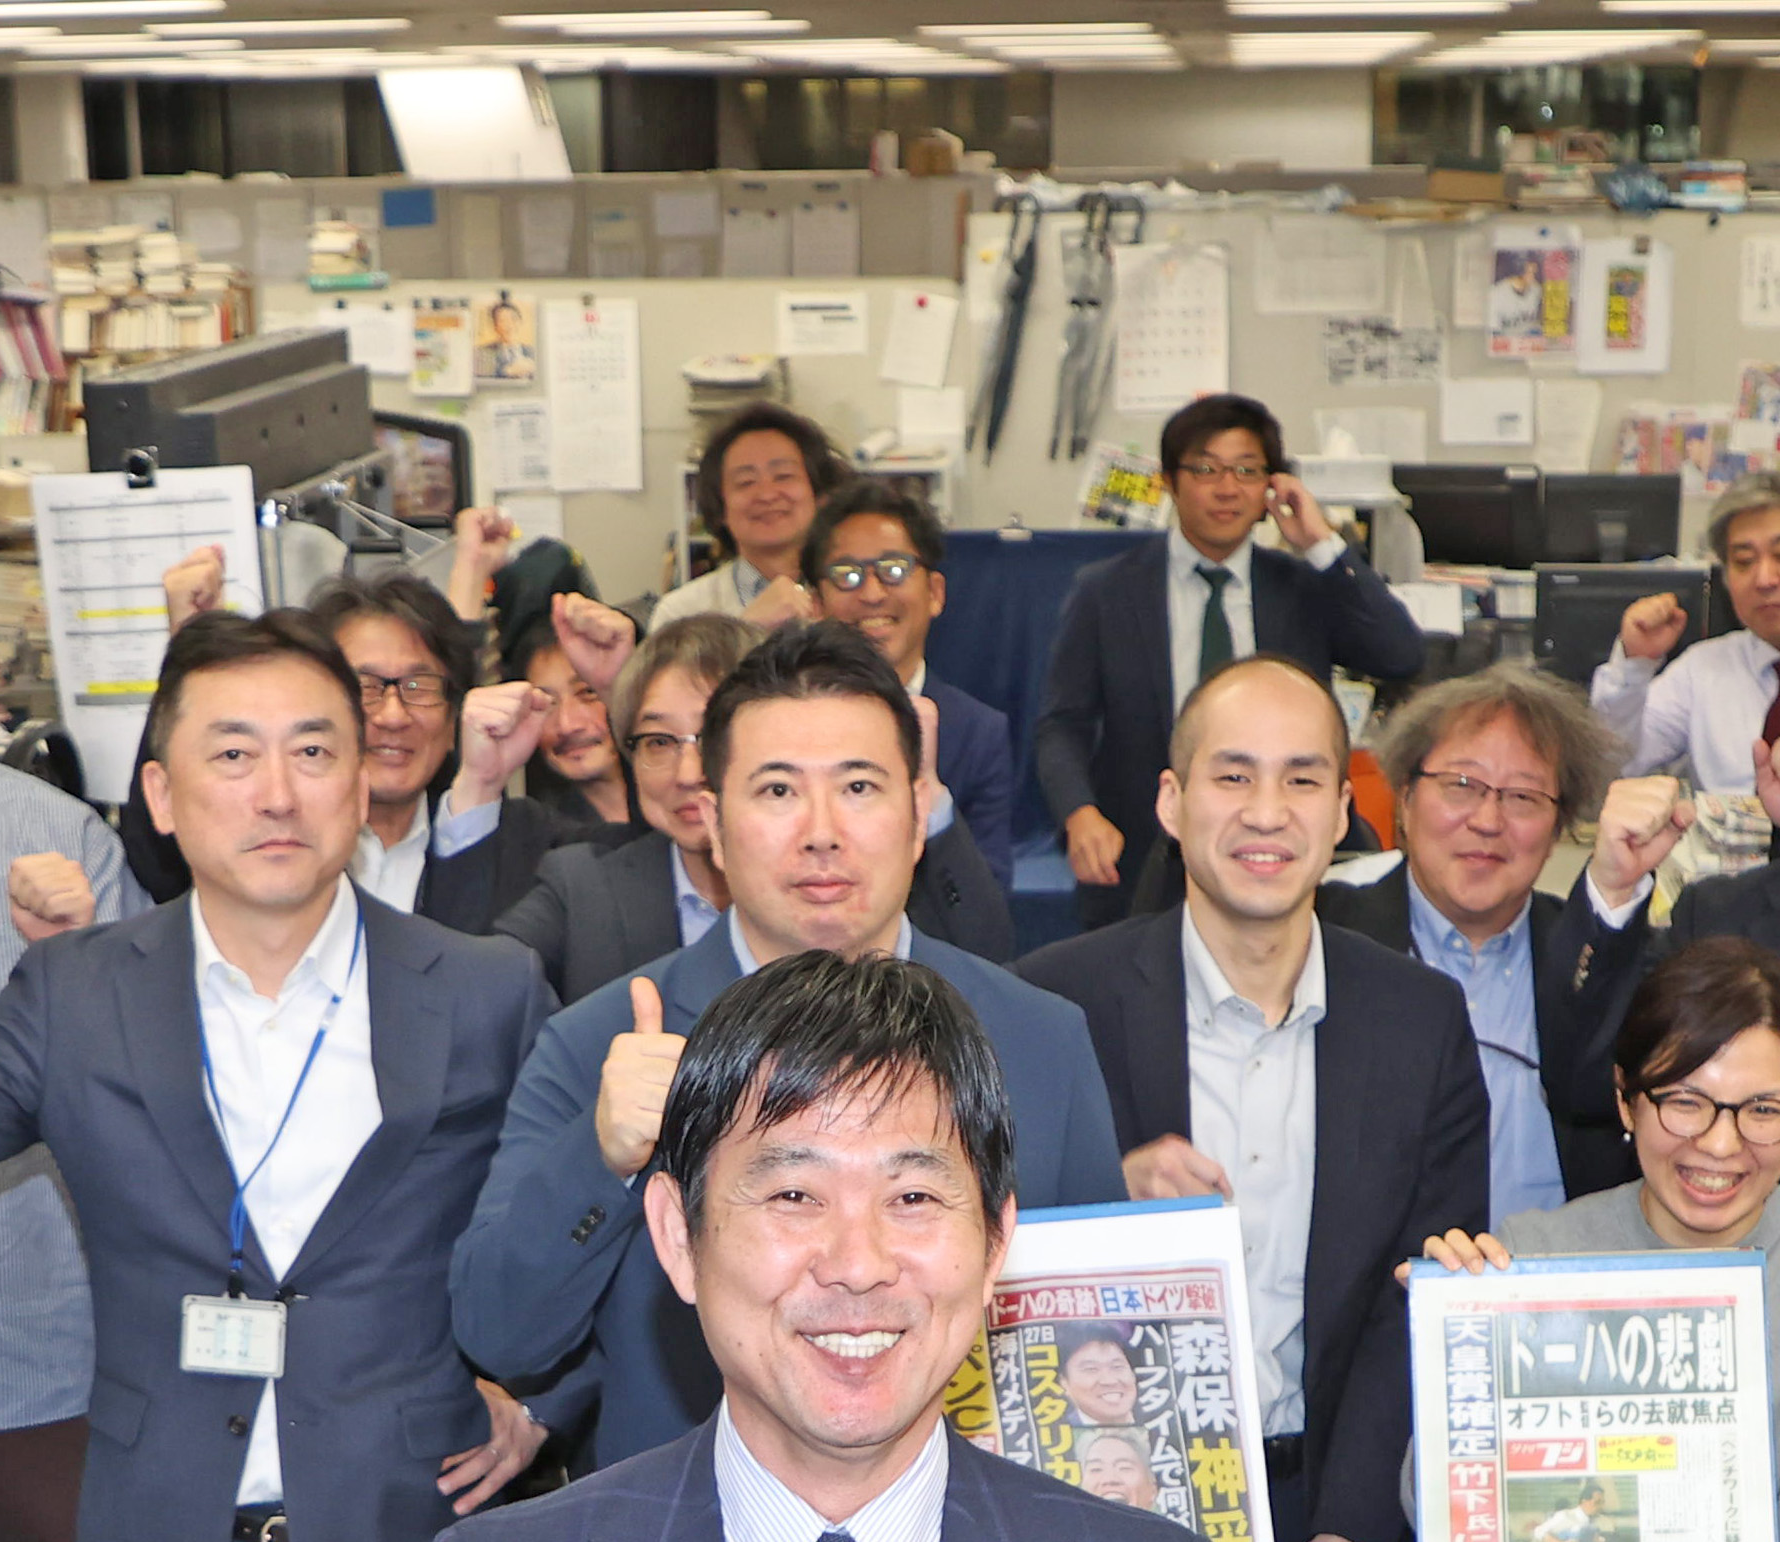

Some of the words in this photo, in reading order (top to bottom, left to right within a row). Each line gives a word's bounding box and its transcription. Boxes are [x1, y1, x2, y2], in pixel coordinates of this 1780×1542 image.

[991, 1286, 1097, 1327] ドーハの奇跡
[1025, 1326, 1054, 1344] 27日
[1447, 1315, 1496, 1456] 天皇賞確定
[1508, 1309, 1736, 1395] ドーハの悲劇
[1026, 1345, 1081, 1485] コスタリカ
